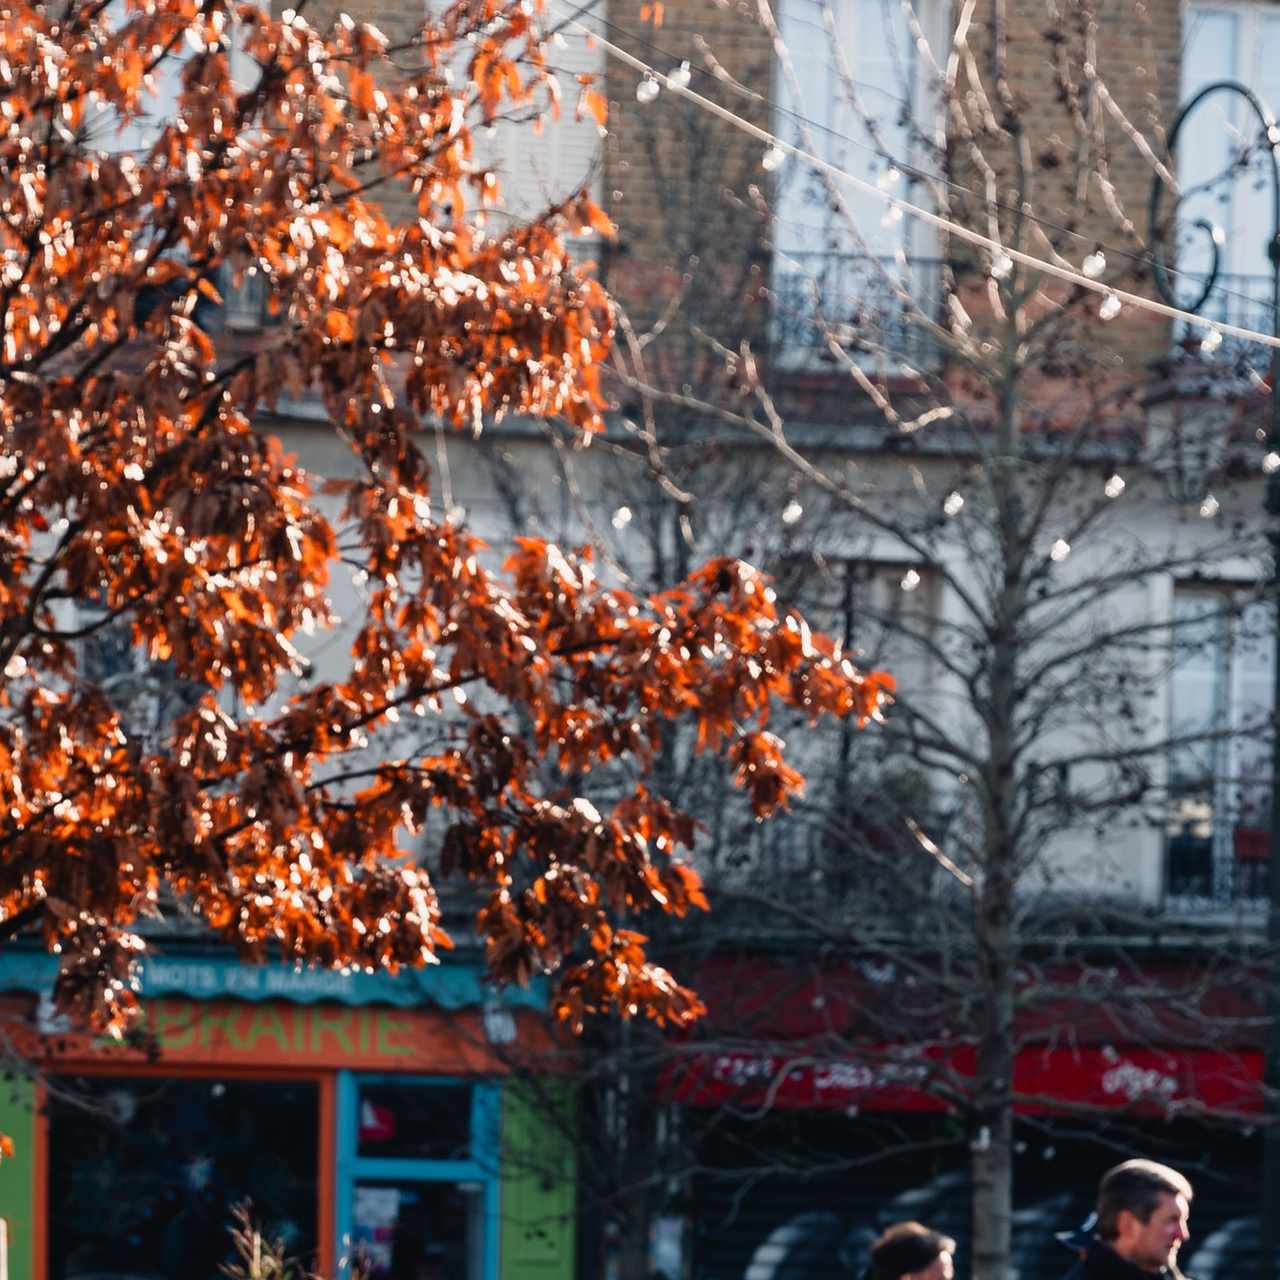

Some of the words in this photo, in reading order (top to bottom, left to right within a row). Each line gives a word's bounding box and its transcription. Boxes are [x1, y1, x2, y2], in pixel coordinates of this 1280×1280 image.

[146, 962, 217, 990] MOTS
[225, 966, 258, 992] EN
[98, 1000, 417, 1057] BRAIRIE
